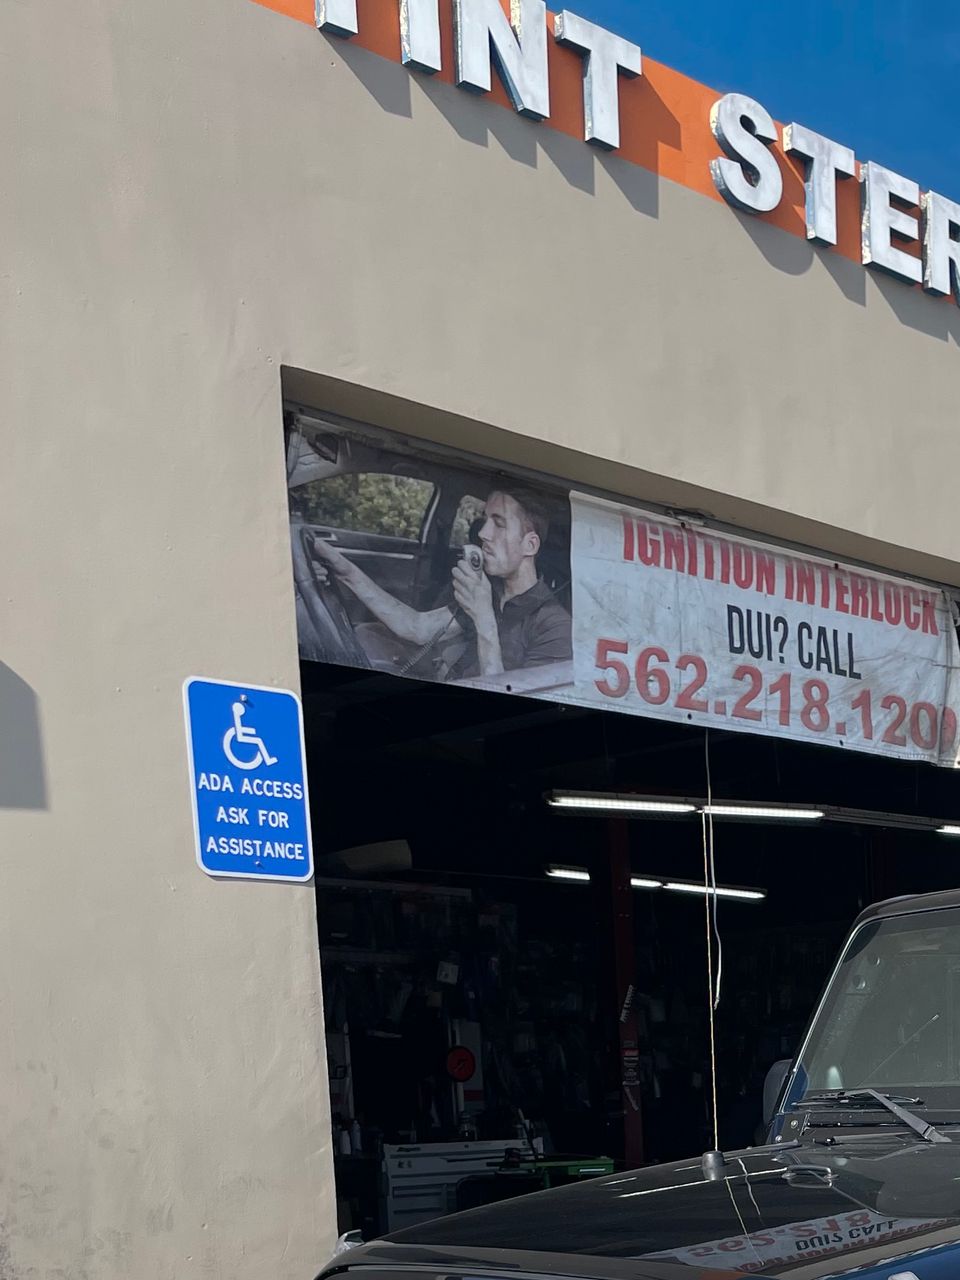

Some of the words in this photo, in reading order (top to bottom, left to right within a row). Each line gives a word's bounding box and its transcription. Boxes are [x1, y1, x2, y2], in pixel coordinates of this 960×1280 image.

[314, 0, 642, 152] INT
[621, 513, 776, 596] IGNITION
[784, 559, 939, 636] INTERLOCK
[727, 603, 787, 663] DUI?
[797, 621, 861, 680] CALL
[198, 773, 234, 793] ADA
[241, 778, 303, 800] ACCESS
[216, 806, 249, 825] ASK
[258, 810, 289, 829] FOR
[206, 836, 304, 860] ASSISTANCE
